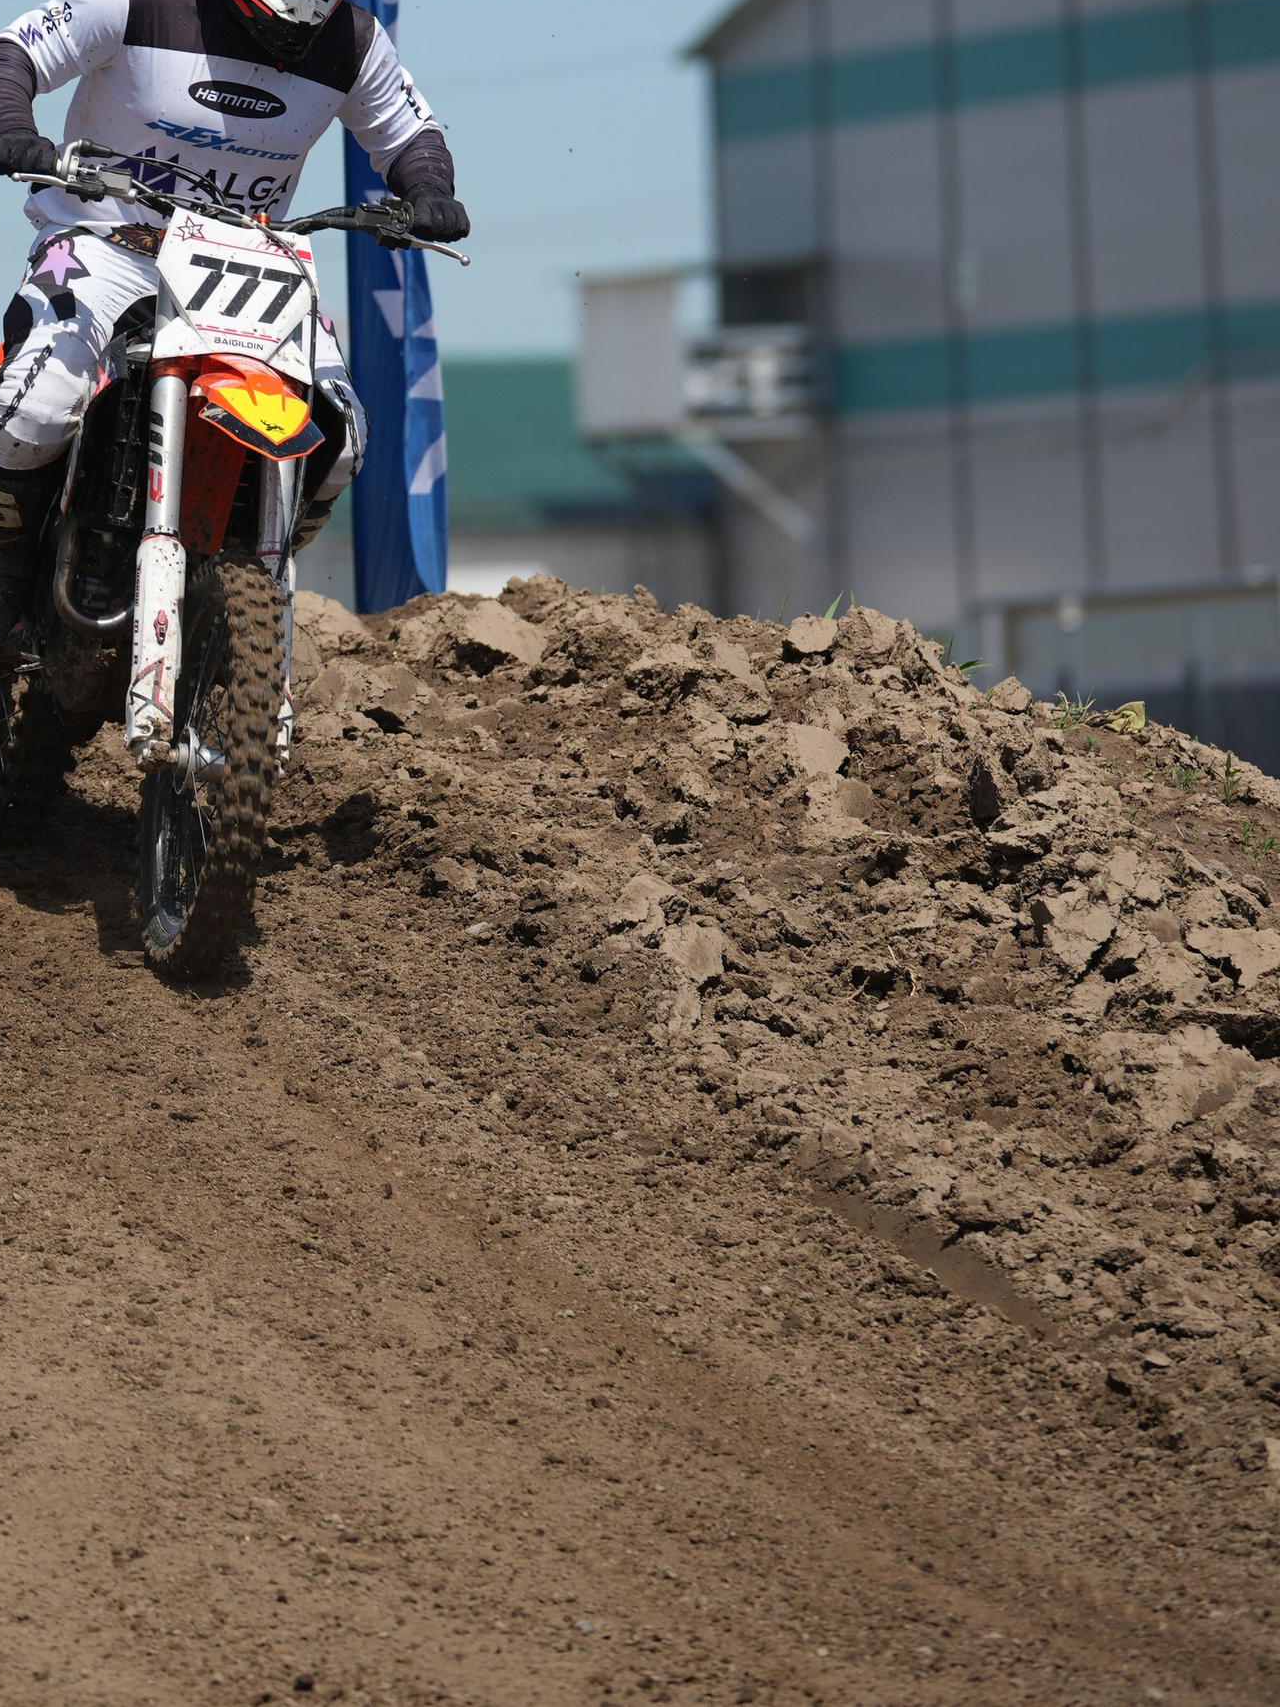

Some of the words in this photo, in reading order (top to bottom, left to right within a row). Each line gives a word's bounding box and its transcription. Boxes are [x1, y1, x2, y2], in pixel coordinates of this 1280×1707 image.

[143, 118, 238, 151] REX
[225, 144, 300, 161] MOTOR
[187, 168, 293, 202] ALGA
[184, 253, 305, 325] 777
[213, 336, 264, 351] BAIGILDIN
